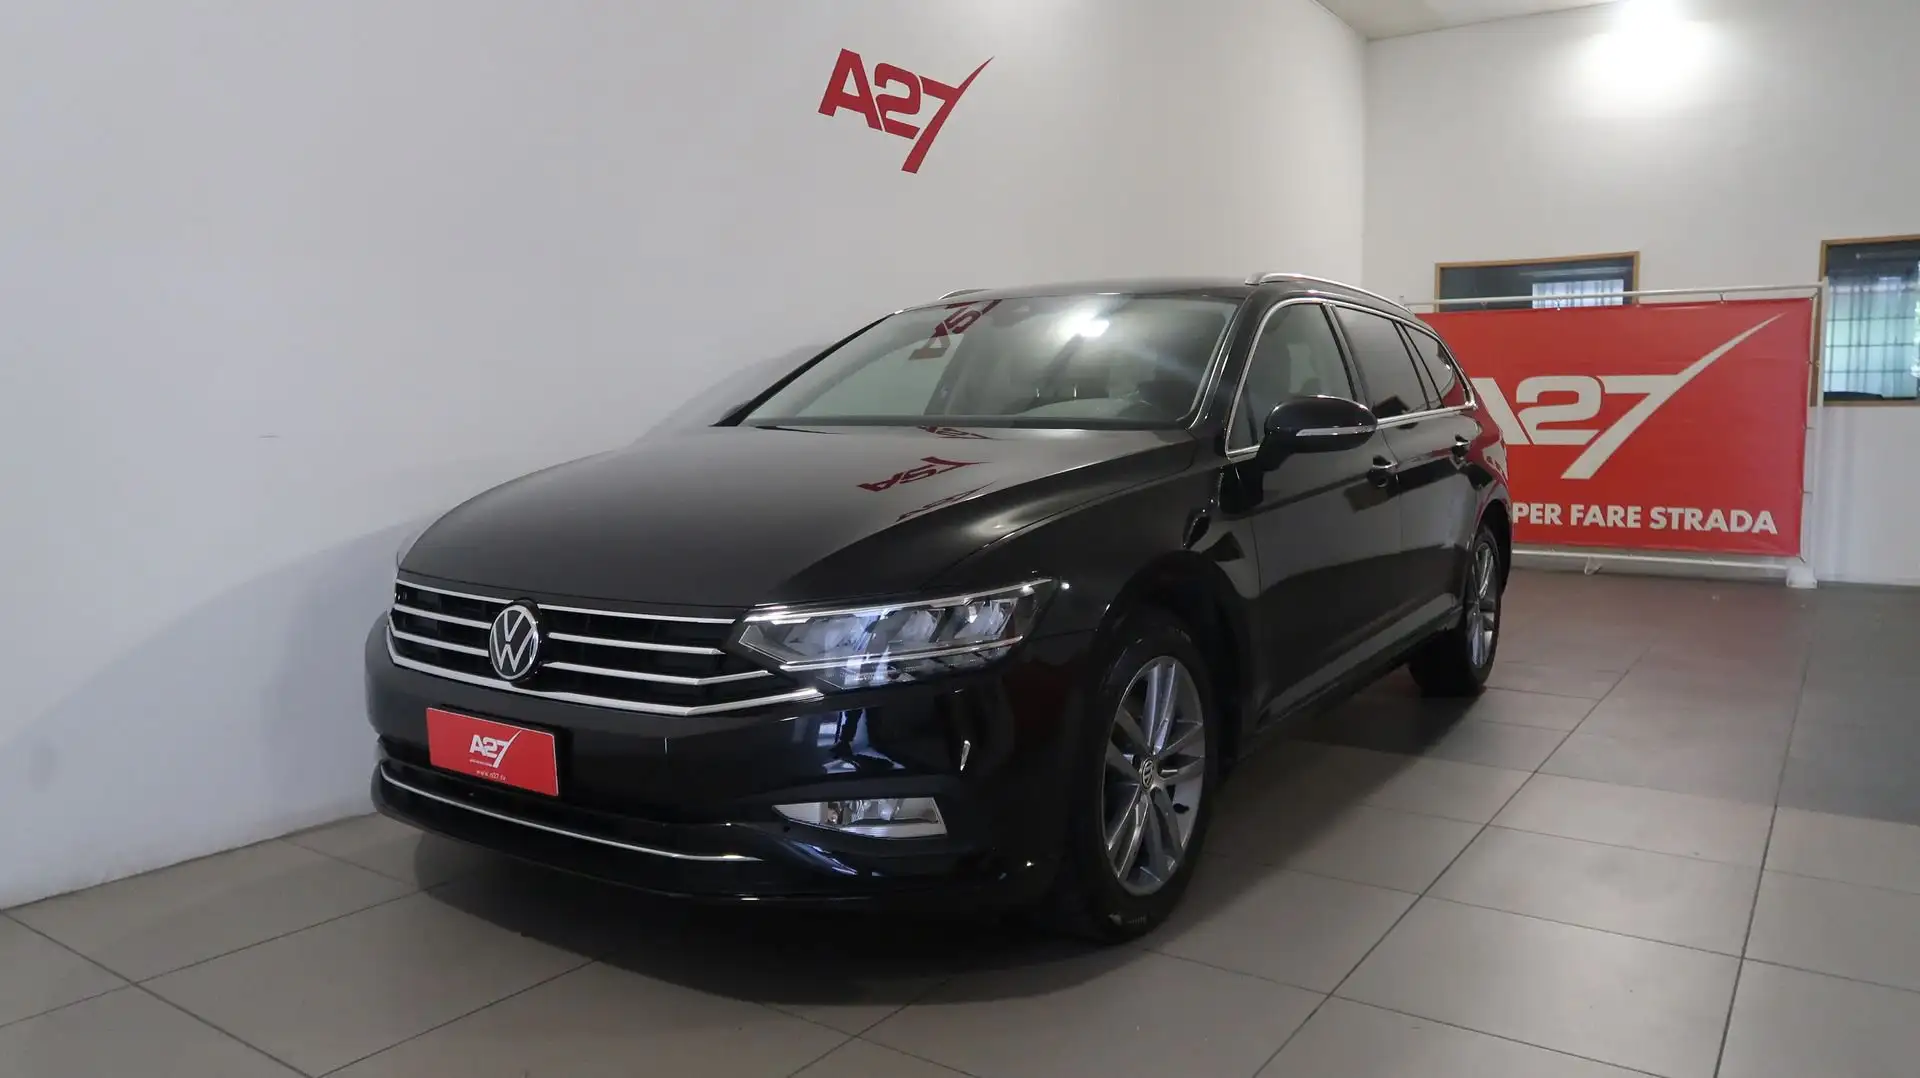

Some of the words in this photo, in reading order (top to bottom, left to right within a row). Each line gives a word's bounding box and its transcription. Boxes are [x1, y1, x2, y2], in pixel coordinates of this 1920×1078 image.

[818, 48, 995, 174] A27
[1511, 502, 1563, 526] PER
[1570, 504, 1642, 529] FARE
[1649, 507, 1779, 535] STRADA
[469, 730, 522, 769] A27
